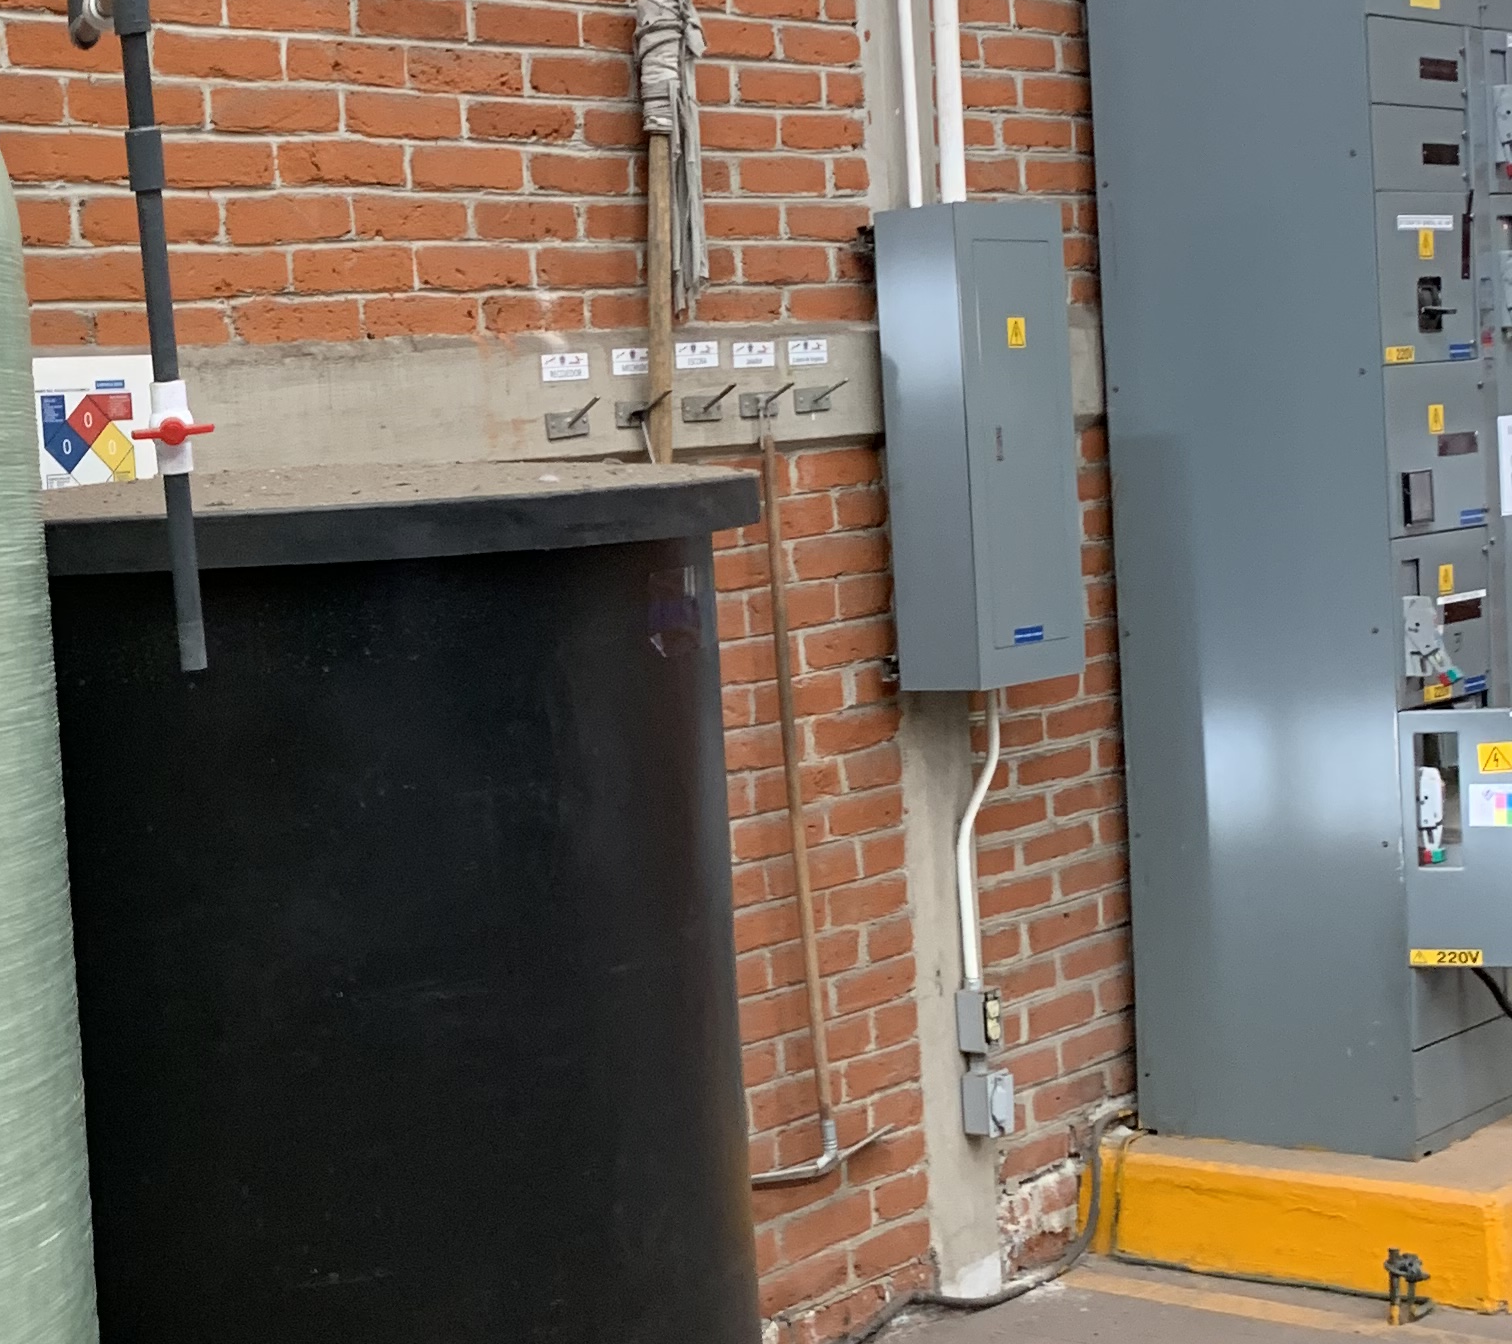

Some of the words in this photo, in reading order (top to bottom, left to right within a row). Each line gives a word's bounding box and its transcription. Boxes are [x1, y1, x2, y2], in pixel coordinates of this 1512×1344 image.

[83, 411, 93, 428] 0
[62, 438, 72, 455] 0
[108, 439, 117, 455] 0
[1436, 951, 1480, 964] 220V
